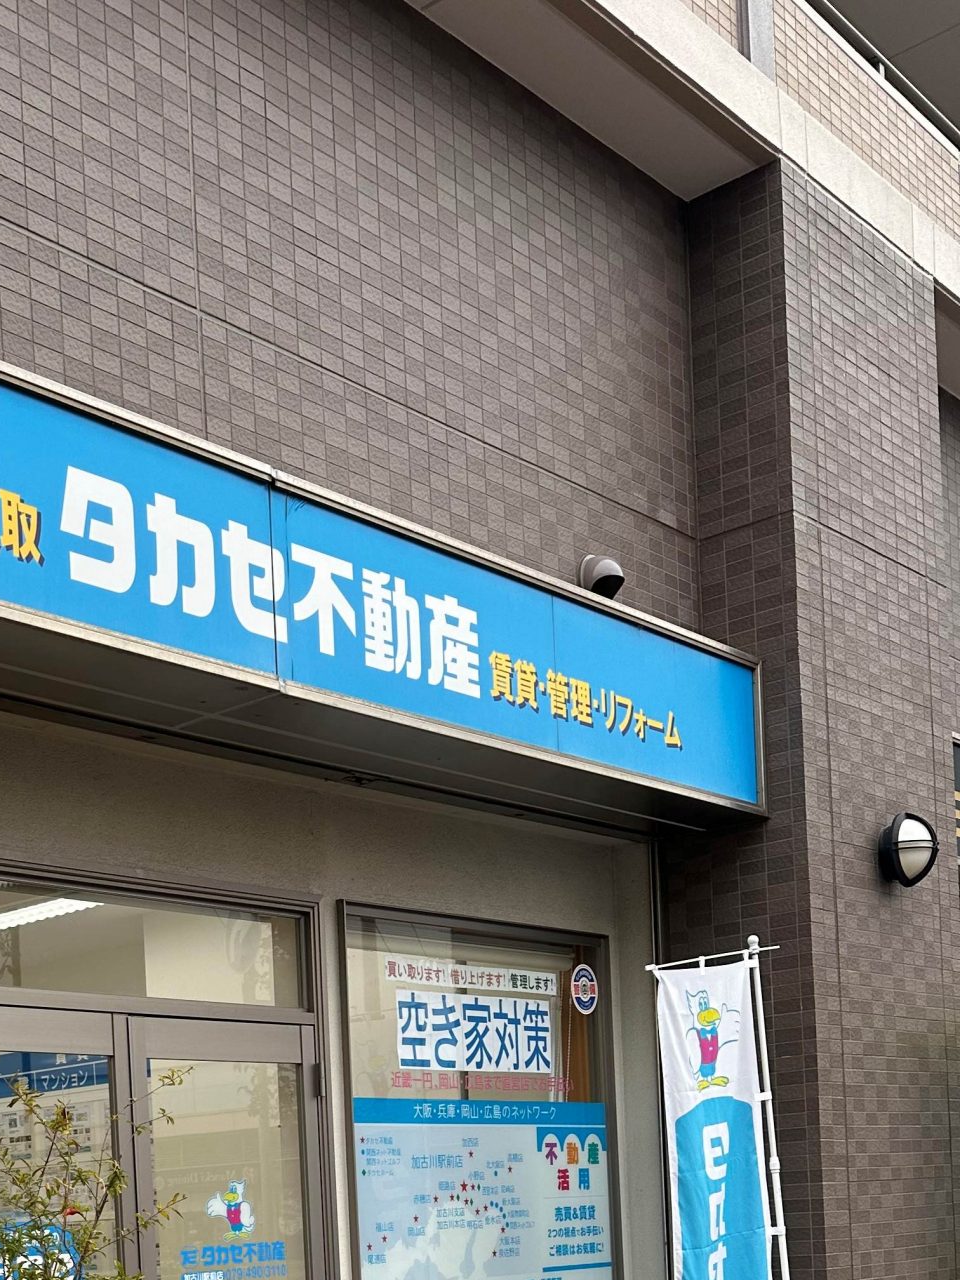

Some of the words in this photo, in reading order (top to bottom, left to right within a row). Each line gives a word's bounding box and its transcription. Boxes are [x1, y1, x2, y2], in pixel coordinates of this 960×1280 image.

[59, 464, 481, 699] タカセ不動産
[488, 650, 682, 749] 賃貸・管理・リフォーム
[397, 992, 551, 1071] 空き家対策
[41, 1069, 88, 1090] マンション
[413, 1102, 557, 1120] 大阪・兵庫・岡山・広島のネットワーク
[411, 1154, 464, 1170] 加古川駅前店
[545, 1141, 600, 1166] 不動産
[557, 1168, 590, 1191] 活用
[554, 1204, 596, 1221] 売買&賃貸
[200, 1240, 286, 1266] タカセ不動産
